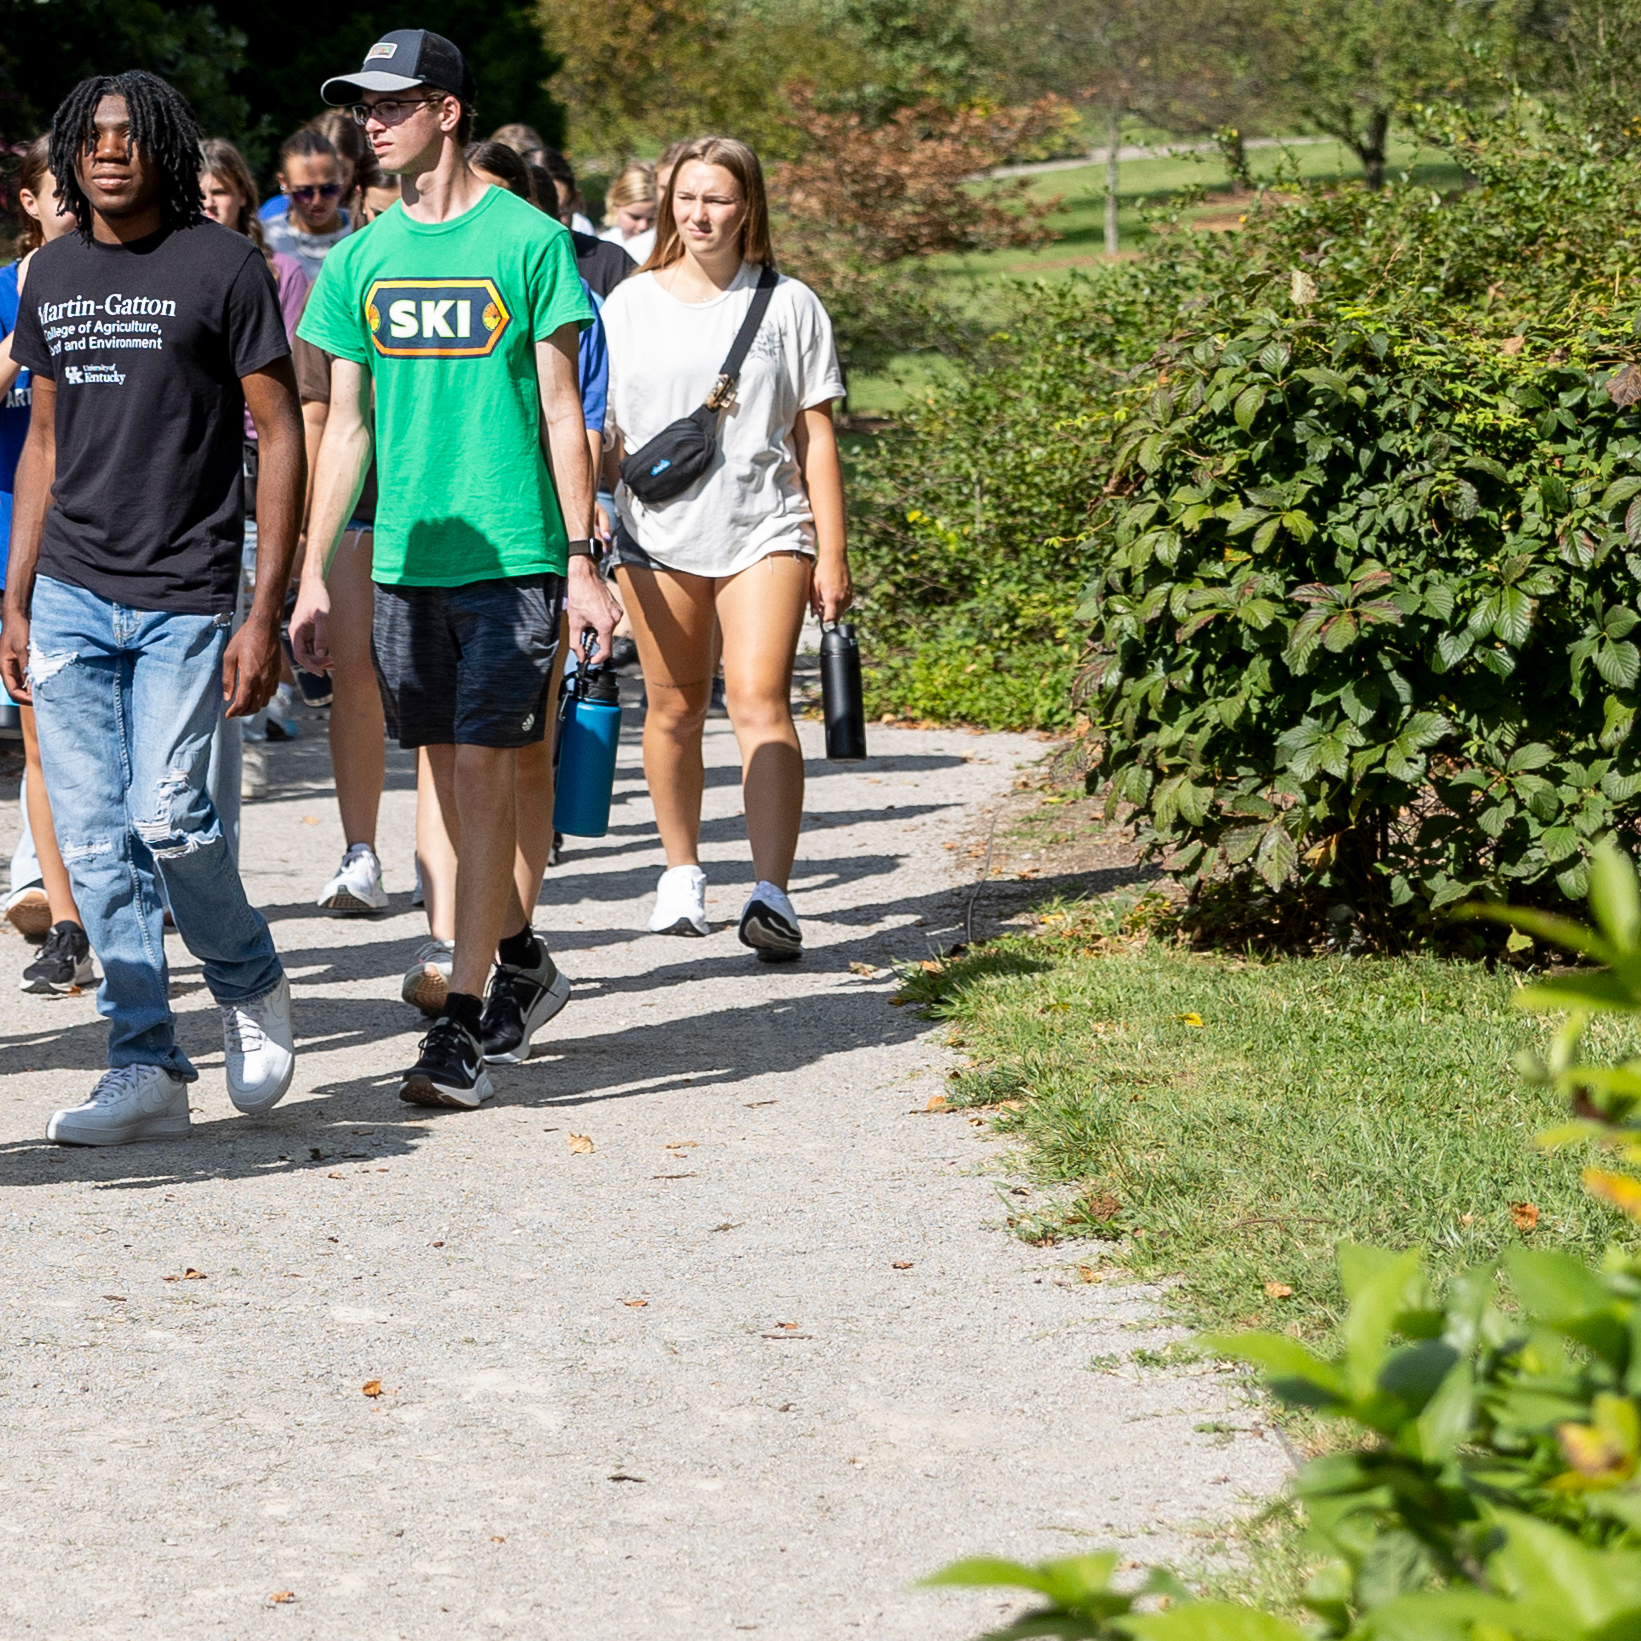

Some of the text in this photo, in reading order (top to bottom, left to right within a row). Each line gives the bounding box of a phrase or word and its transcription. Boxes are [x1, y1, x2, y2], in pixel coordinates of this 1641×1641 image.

[78, 320, 92, 334] of
[93, 319, 162, 335] Agriculture,
[388, 299, 471, 339] SKI
[64, 337, 86, 352] and
[89, 335, 162, 350] Environment
[85, 371, 126, 385] Kentucky
